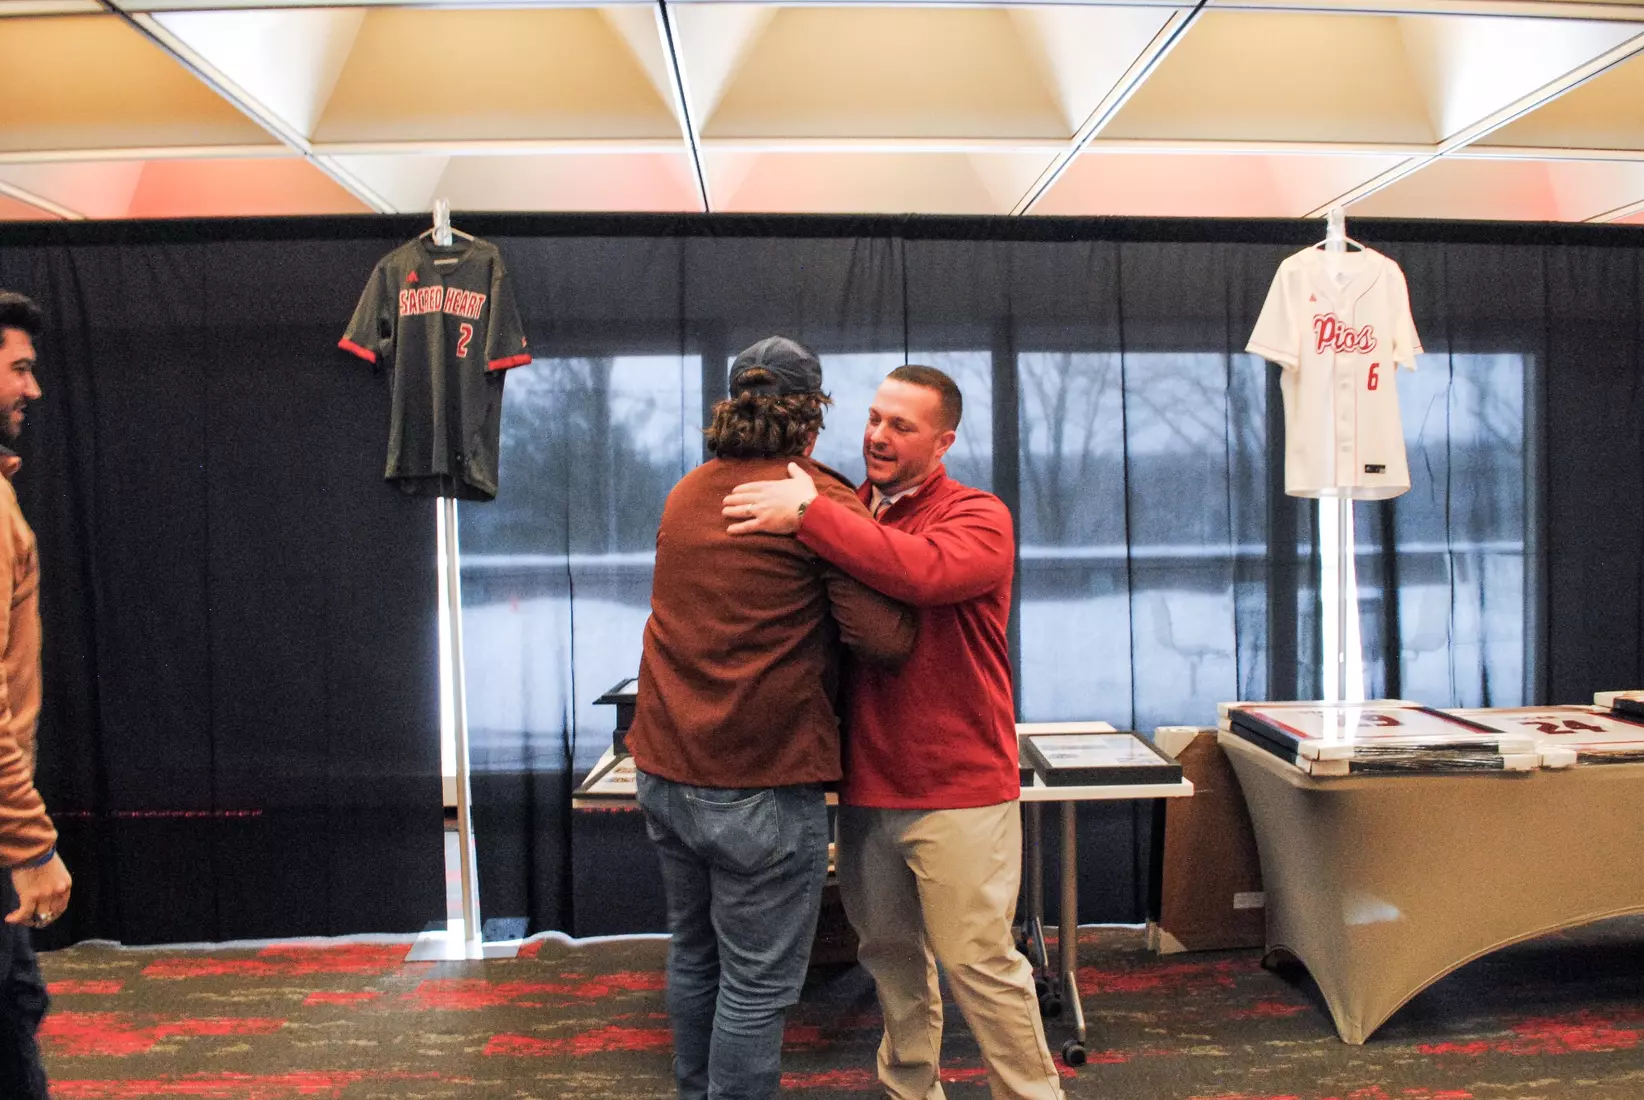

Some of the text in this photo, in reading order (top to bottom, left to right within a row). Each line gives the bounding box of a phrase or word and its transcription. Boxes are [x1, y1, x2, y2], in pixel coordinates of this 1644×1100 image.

[399, 285, 487, 320] SACRED HEART
[456, 322, 473, 358] 2
[1313, 312, 1377, 355] Pios
[1367, 362, 1380, 391] 6
[1519, 719, 1609, 735] 24
